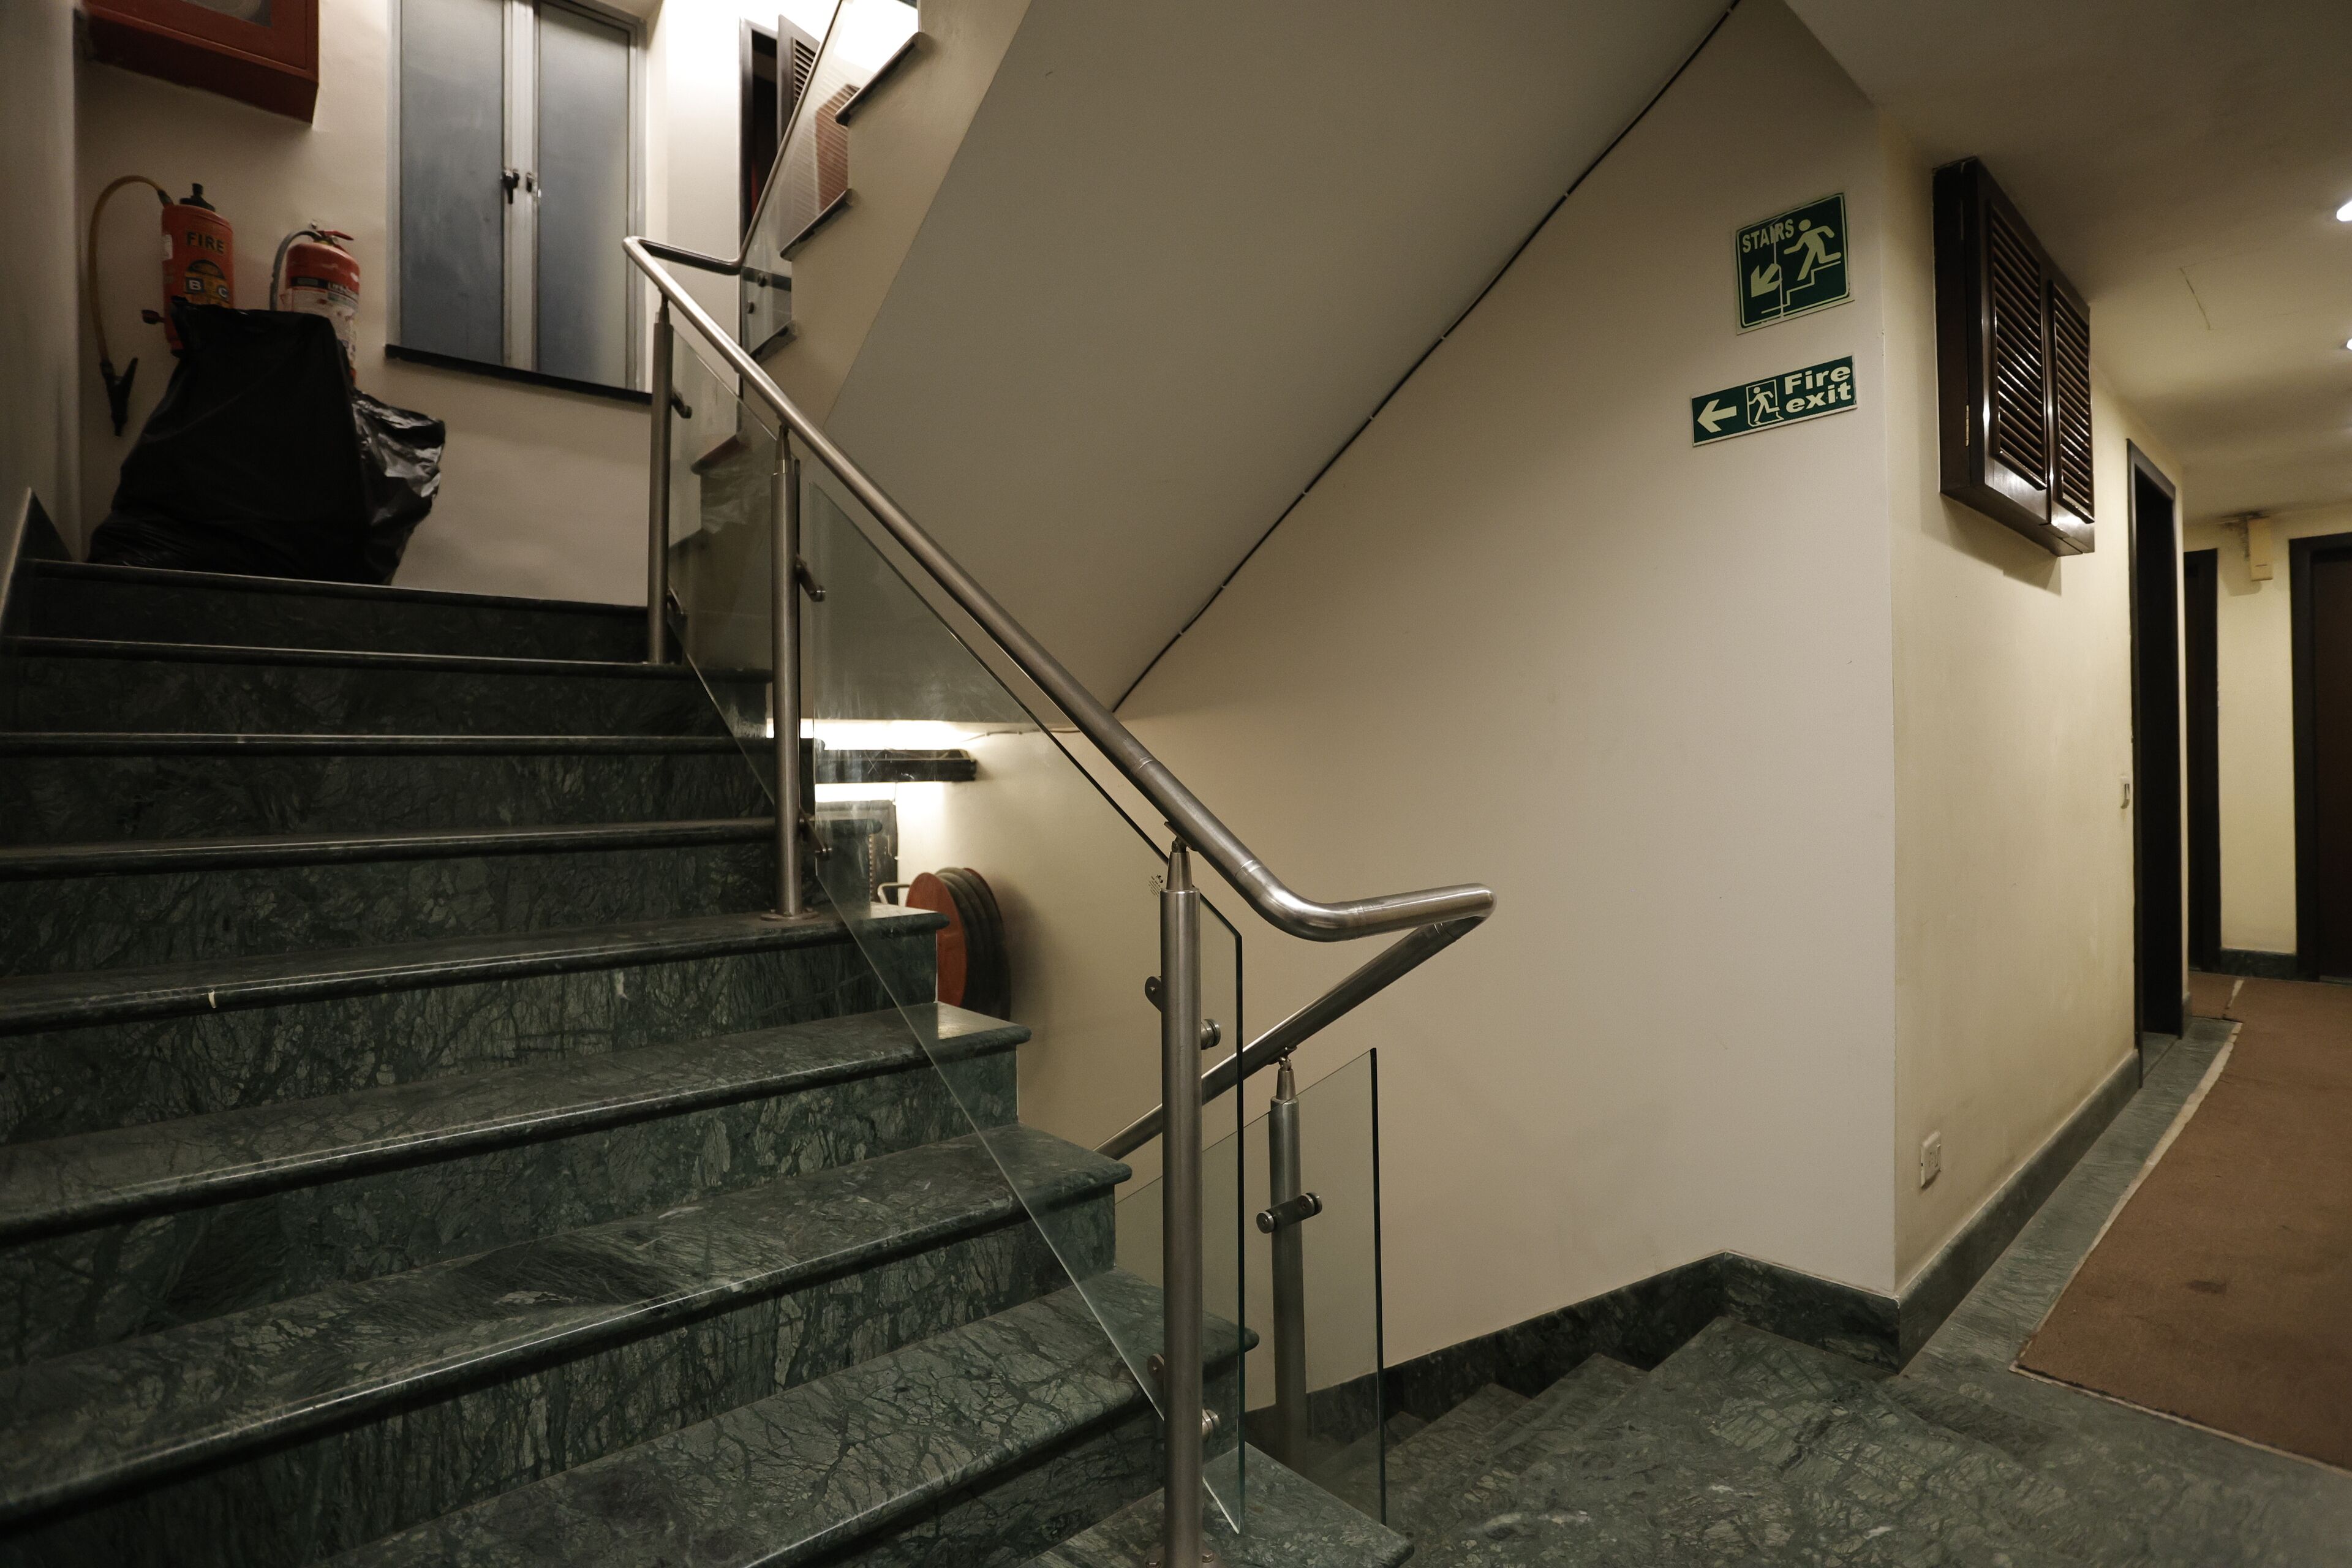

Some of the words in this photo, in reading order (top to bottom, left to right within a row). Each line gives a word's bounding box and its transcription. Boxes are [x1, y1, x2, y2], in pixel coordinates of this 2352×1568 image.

[187, 232, 224, 254] FIRE
[1743, 219, 1794, 253] STAIRS
[189, 280, 201, 290] B
[1785, 366, 1850, 394] Fire
[1786, 382, 1851, 413] exit
